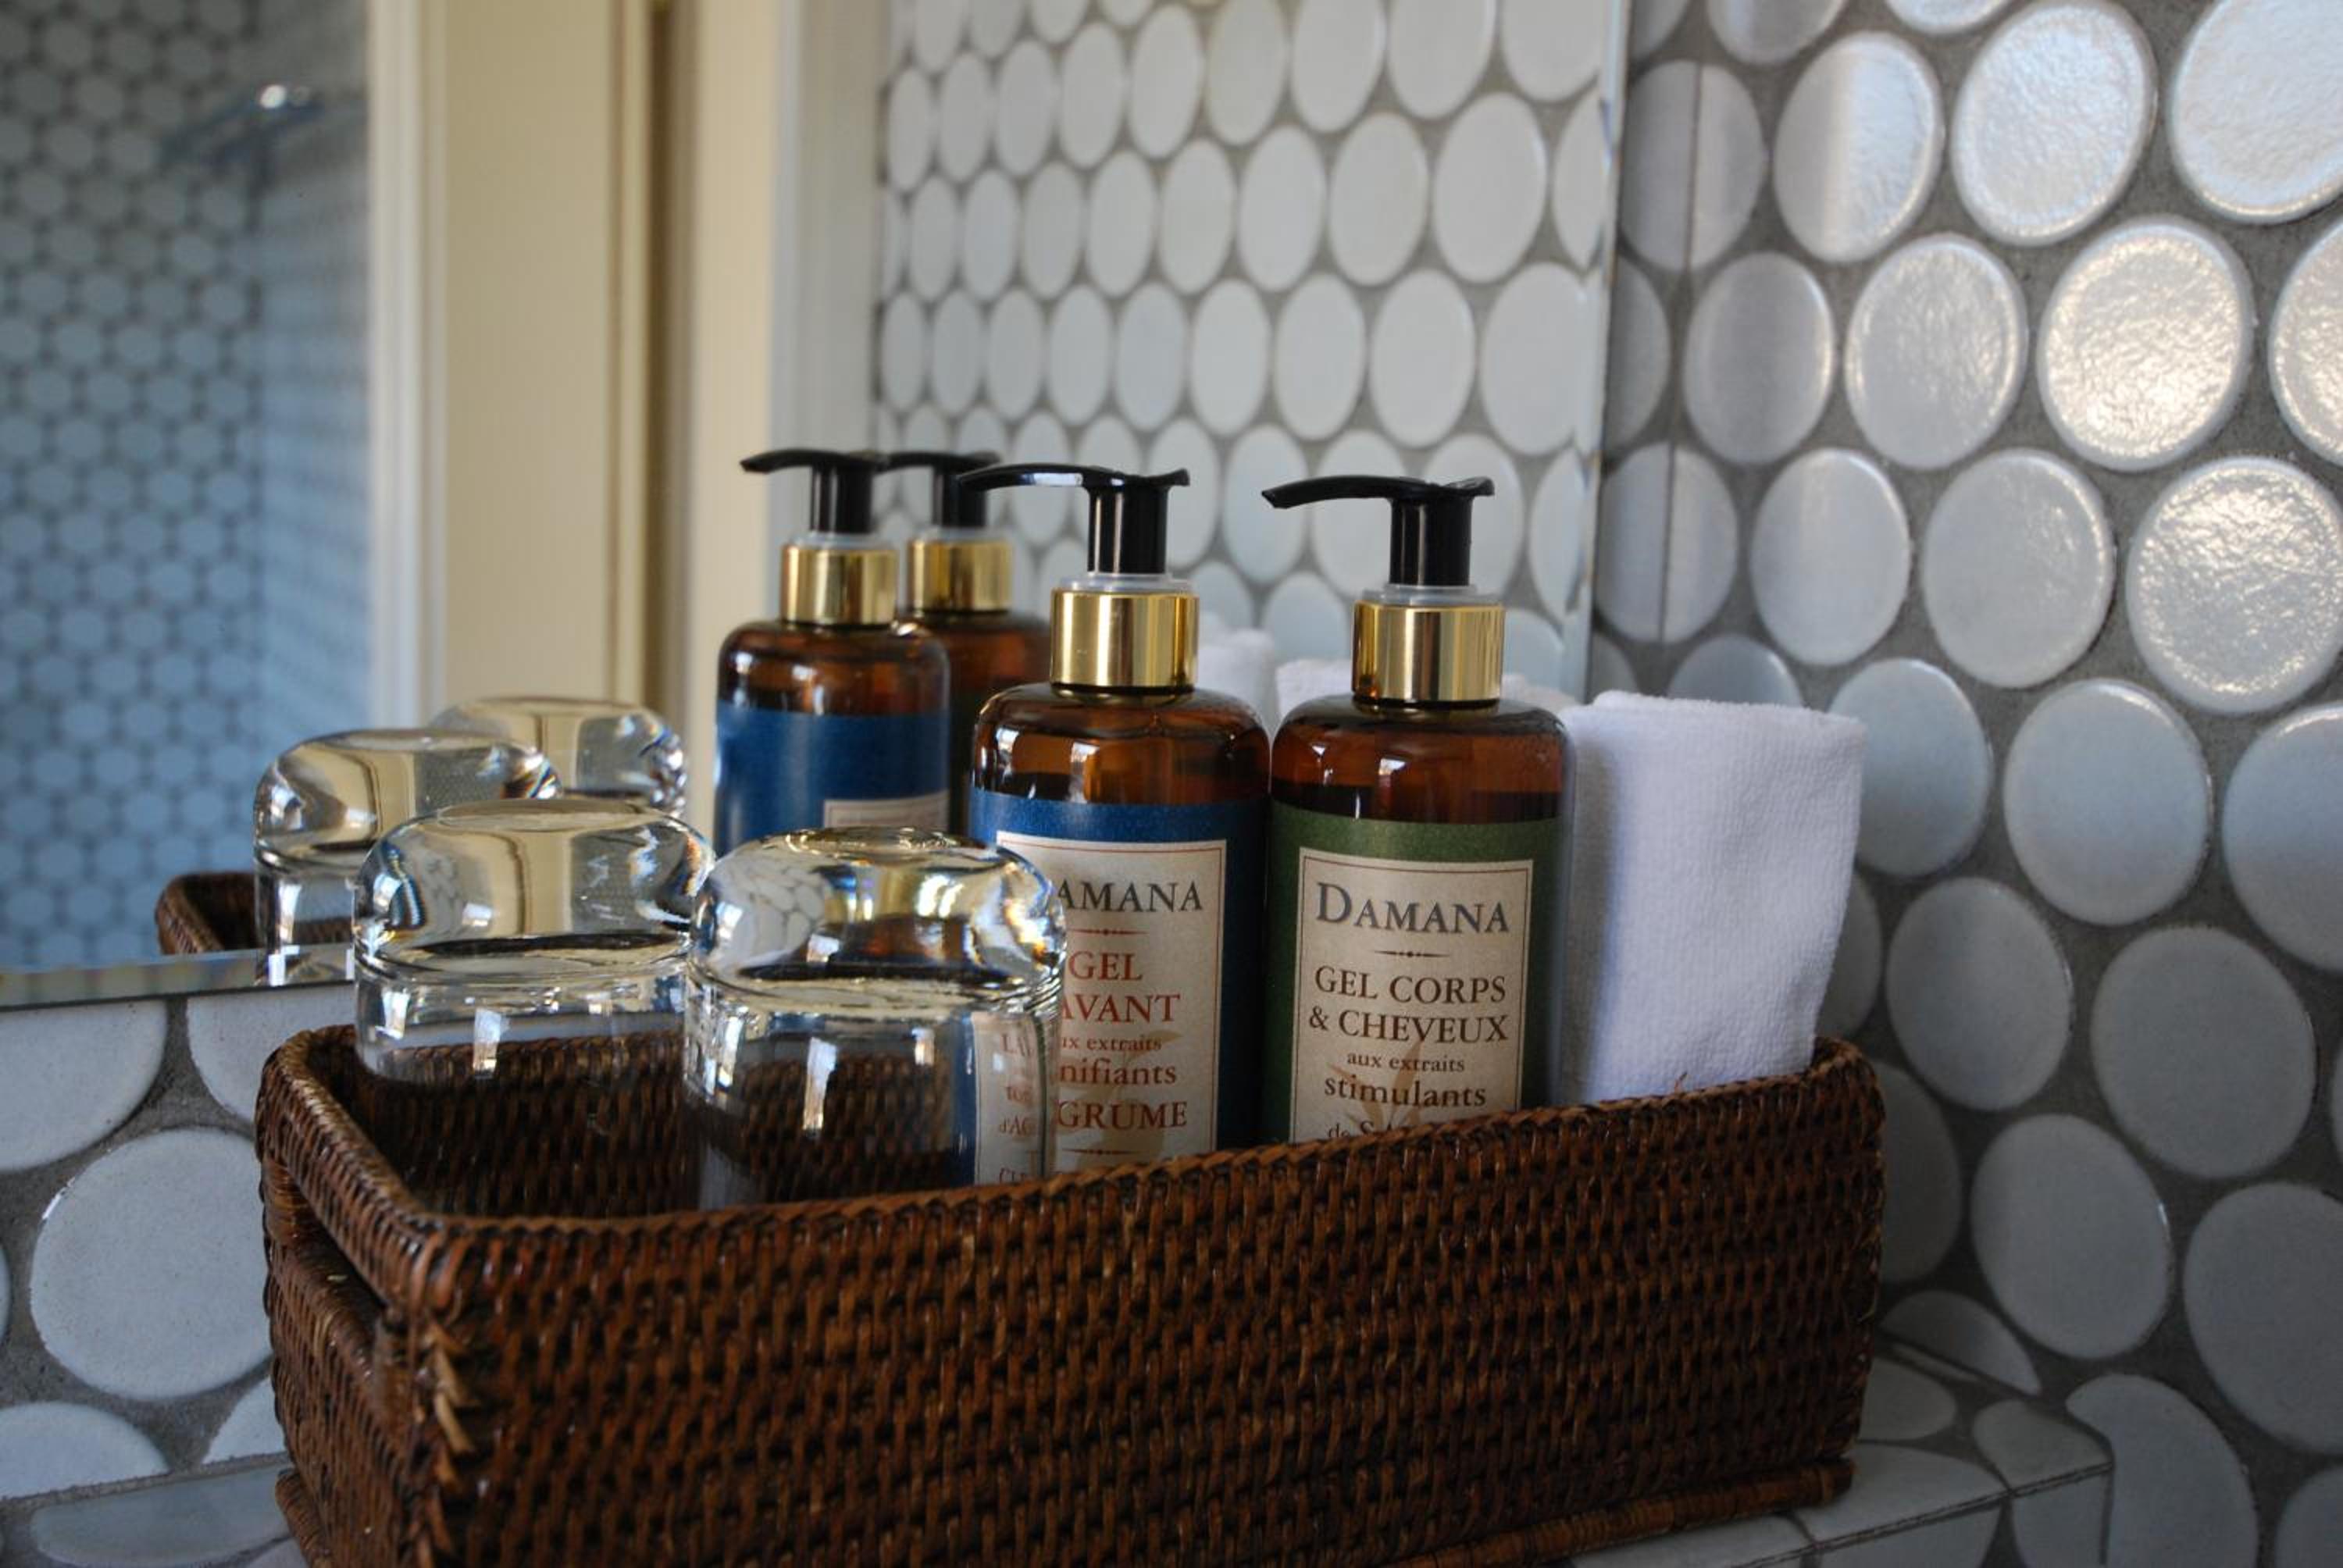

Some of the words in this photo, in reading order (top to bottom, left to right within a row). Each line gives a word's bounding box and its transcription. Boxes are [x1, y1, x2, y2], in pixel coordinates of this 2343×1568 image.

[1057, 879, 1203, 913] AMANA
[1316, 882, 1510, 933] DAMANA
[1068, 950, 1143, 981] GEL
[1314, 965, 1378, 1000] GEL
[1389, 975, 1506, 1005] CORPS
[1309, 1006, 1328, 1031] &
[1339, 1009, 1509, 1044] CHEVEUX
[1086, 1035, 1162, 1052] extraits
[1060, 1057, 1178, 1085] nifiants
[1346, 1053, 1382, 1068] aux
[1389, 1054, 1465, 1073] extraits
[1324, 1074, 1486, 1107] stimulants
[1057, 1101, 1188, 1131] GRUME
